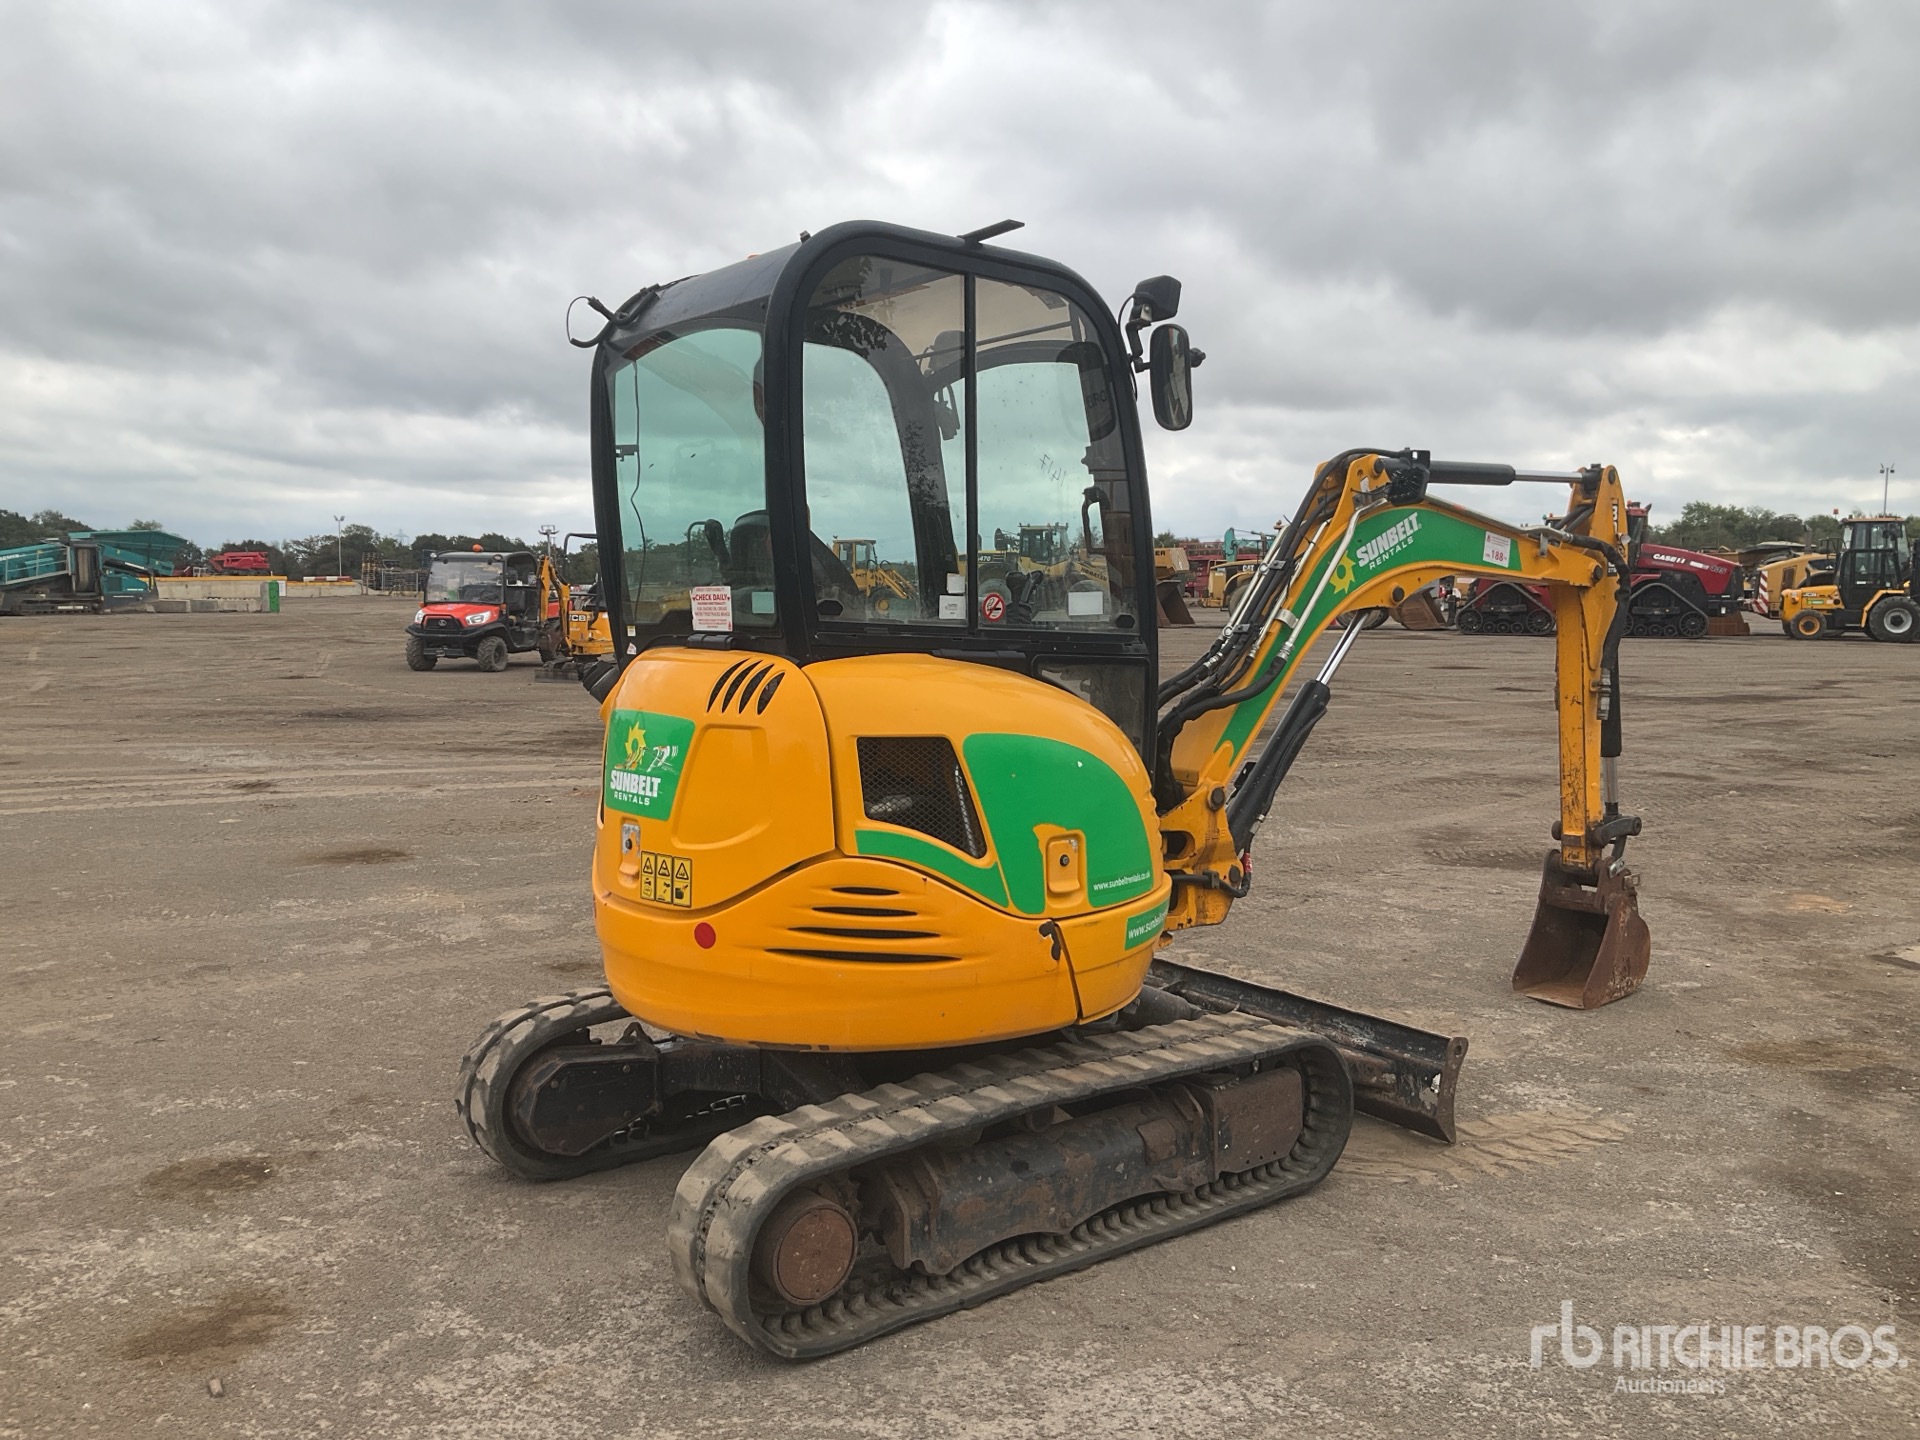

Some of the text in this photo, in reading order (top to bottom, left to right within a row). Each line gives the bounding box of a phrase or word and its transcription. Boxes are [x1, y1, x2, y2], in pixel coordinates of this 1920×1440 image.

[1355, 511, 1417, 568] SUNBELT
[1369, 537, 1414, 570] RENTALS
[1652, 553, 1677, 563] CASE
[1242, 564, 1255, 572] CAT
[695, 593, 728, 601] CHECK DAILY
[610, 769, 661, 798] SUNBELT
[613, 791, 650, 806] RENTALS
[1093, 871, 1150, 891] www.sunbeltrentals.co.uk
